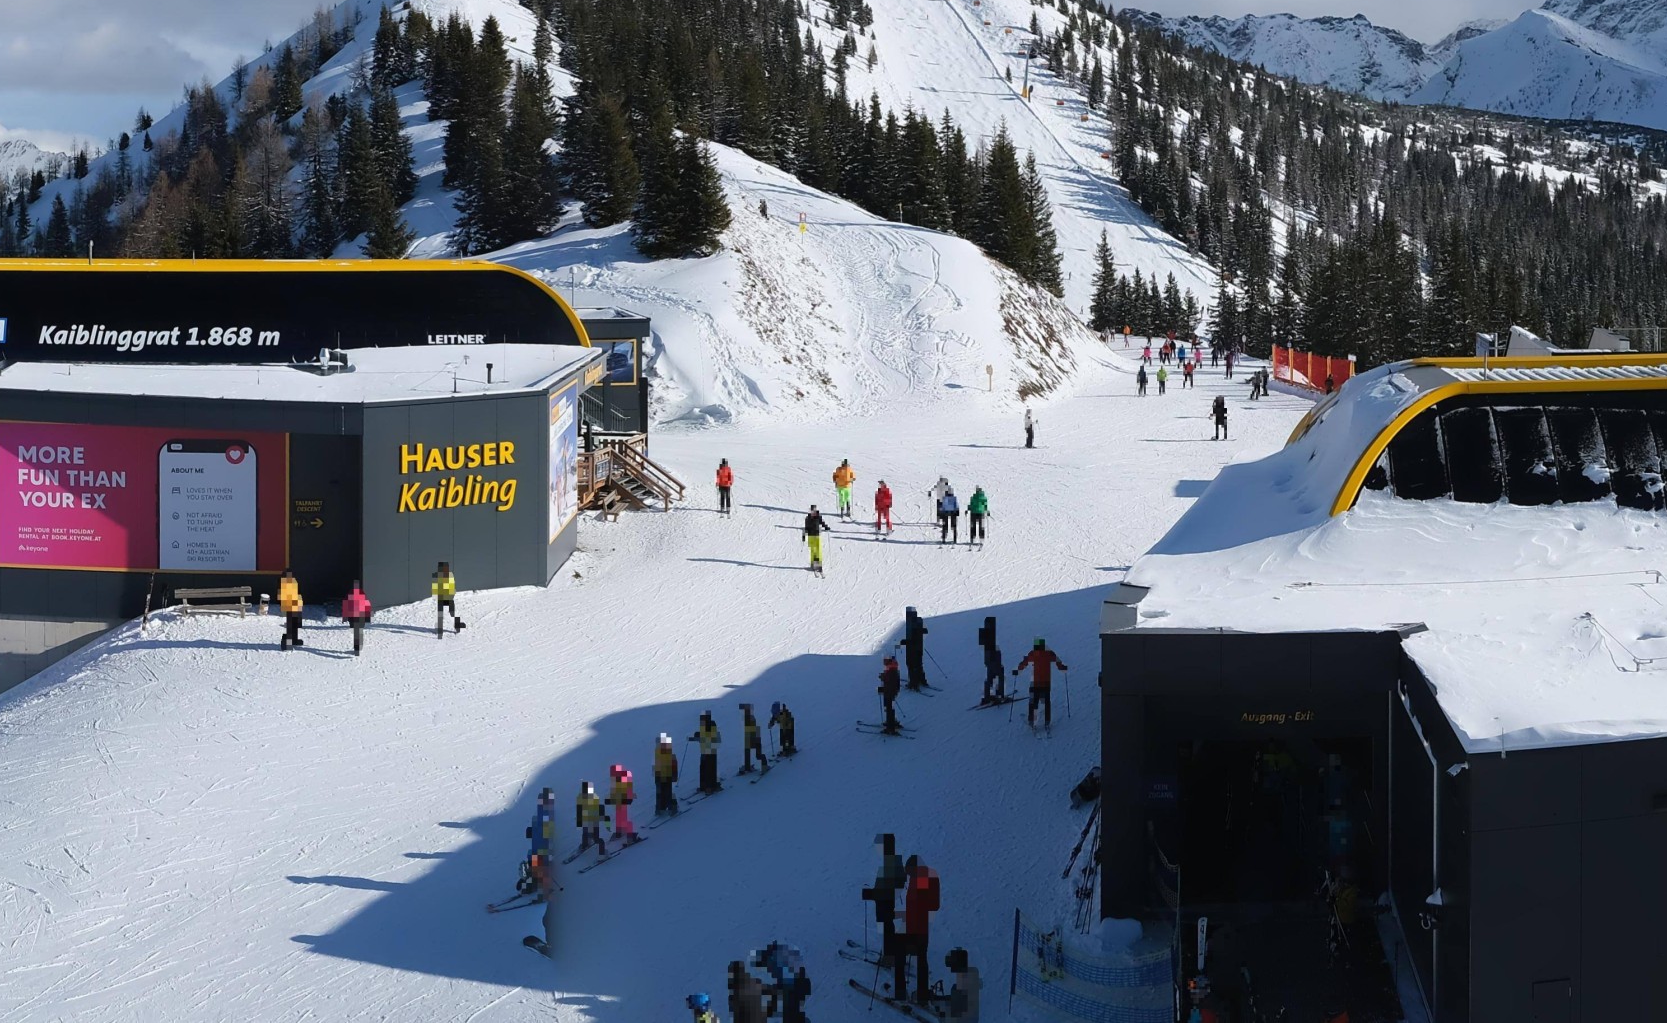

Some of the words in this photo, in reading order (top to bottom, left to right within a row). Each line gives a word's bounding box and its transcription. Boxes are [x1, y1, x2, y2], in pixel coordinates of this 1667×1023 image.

[38, 325, 180, 352] Kaiblinggrat
[185, 326, 252, 346] 1.868
[257, 330, 280, 346] m
[427, 334, 485, 345] LEITNER
[18, 445, 85, 465] MORE
[400, 441, 515, 474] HAUSER
[17, 468, 59, 486] FUN
[66, 469, 126, 488] THAN
[18, 491, 75, 508] YOUR
[81, 493, 107, 509] EX
[398, 474, 518, 513] Kaibling
[1241, 712, 1286, 725] Ausgang
